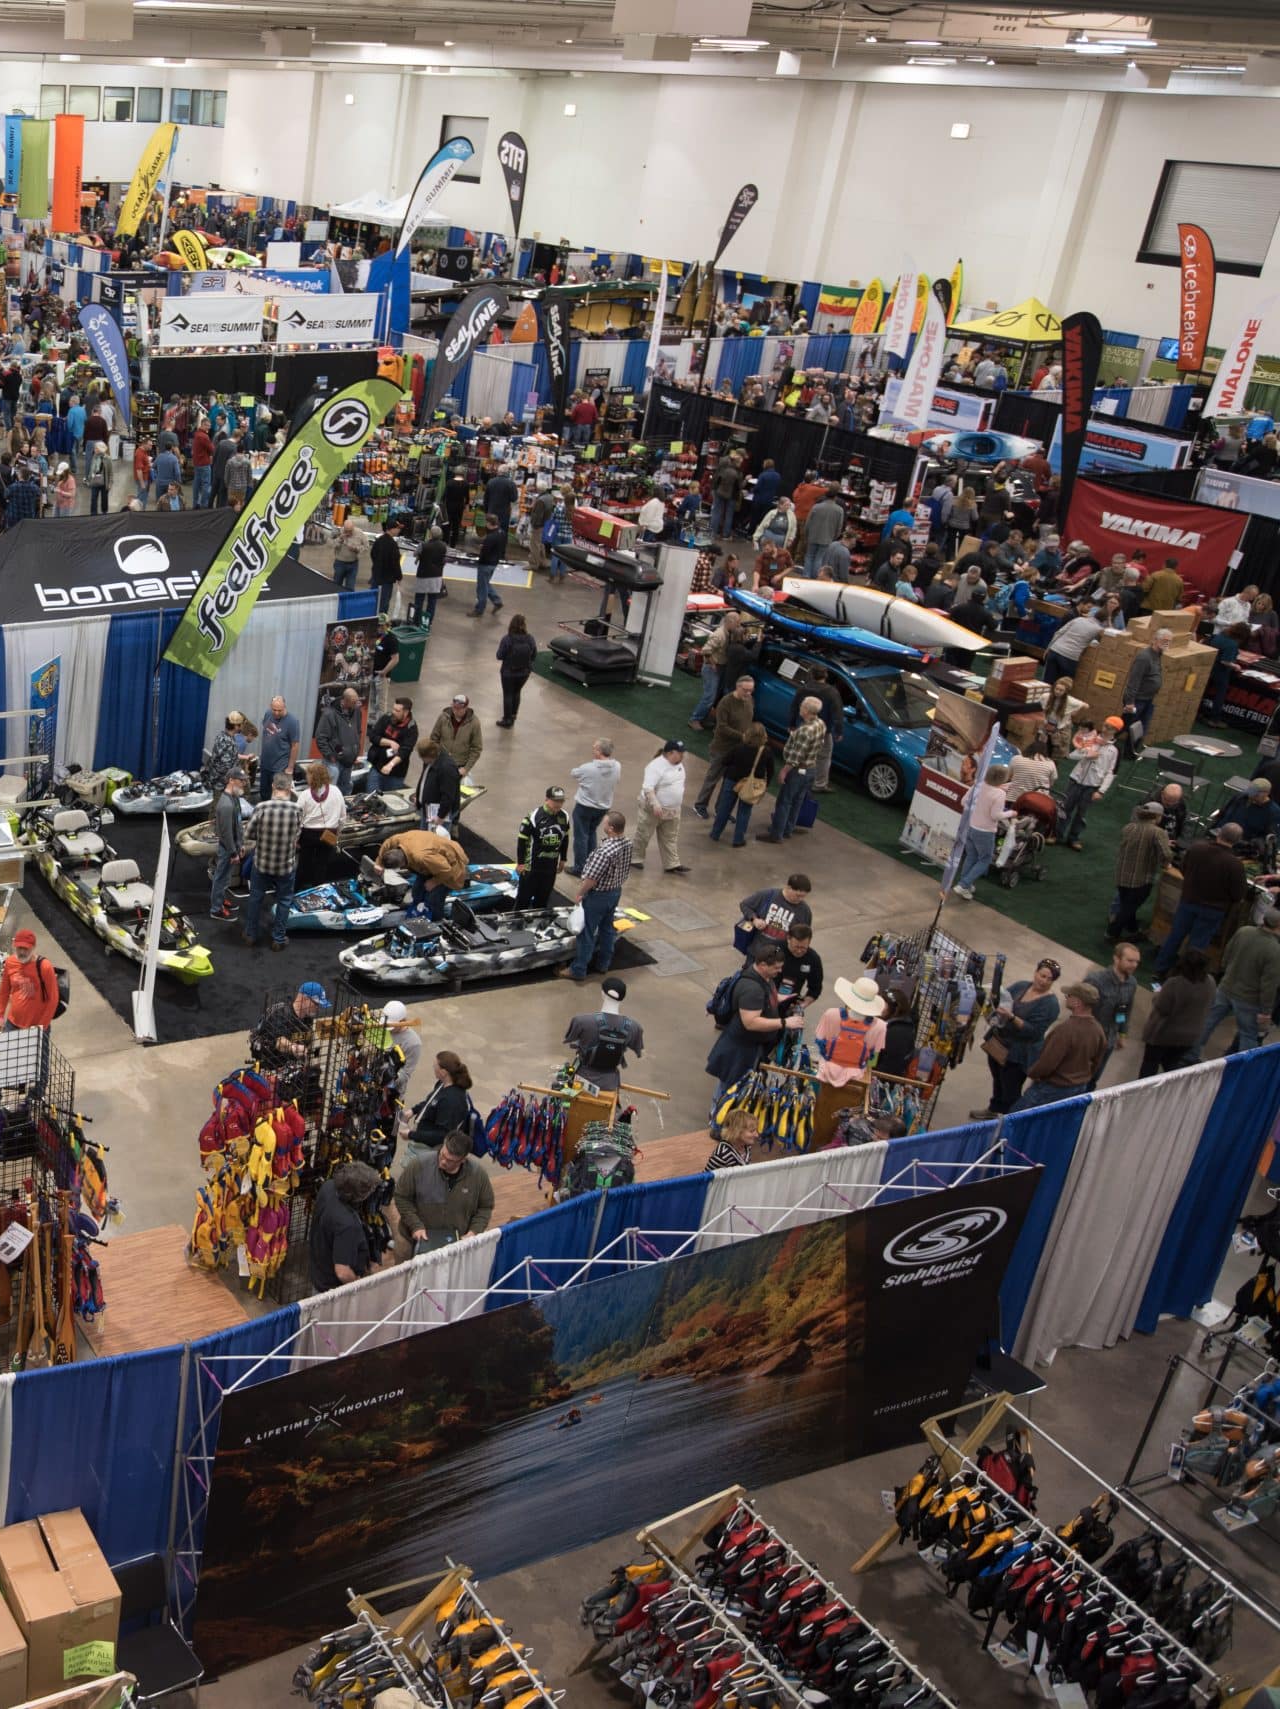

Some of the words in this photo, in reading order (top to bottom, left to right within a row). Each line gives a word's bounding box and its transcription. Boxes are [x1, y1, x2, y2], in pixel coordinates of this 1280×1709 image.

[182, 237, 202, 270] KEEN
[1182, 263, 1201, 359] icebreaker
[93, 328, 127, 391] rutabaga
[1217, 319, 1263, 409] MALONE
[197, 450, 320, 653] feelfree
[1100, 512, 1201, 551] YAKIMA
[34, 570, 201, 607] bonafi
[926, 779, 959, 801] YAKIMA
[882, 1253, 982, 1288] Stohlquist
[244, 1437, 252, 1445] A
[257, 1419, 310, 1441] LIFETIME
[315, 1412, 330, 1422] OF
[334, 1388, 405, 1417] INNOVATION
